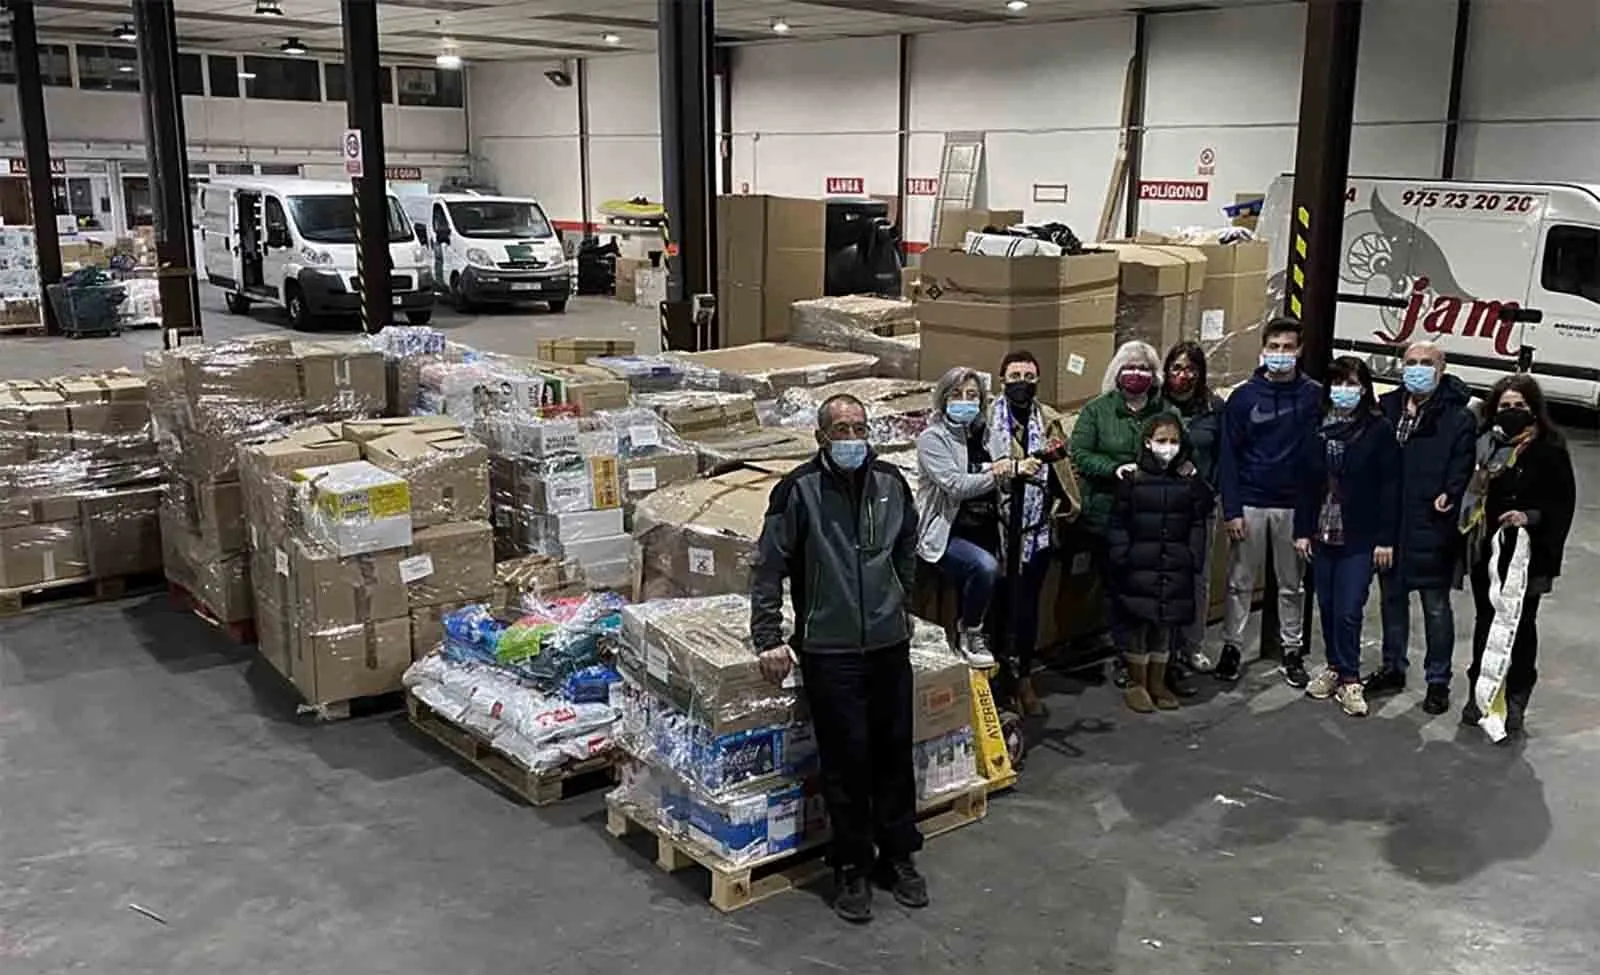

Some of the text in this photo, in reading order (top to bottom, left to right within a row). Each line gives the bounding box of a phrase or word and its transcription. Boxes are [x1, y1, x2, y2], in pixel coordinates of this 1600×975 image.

[1141, 183, 1204, 199] POLÍGONO
[1402, 190, 1439, 207] 975
[1442, 193, 1469, 209] 23
[1472, 194, 1501, 211] 20
[1504, 195, 1533, 212] 20
